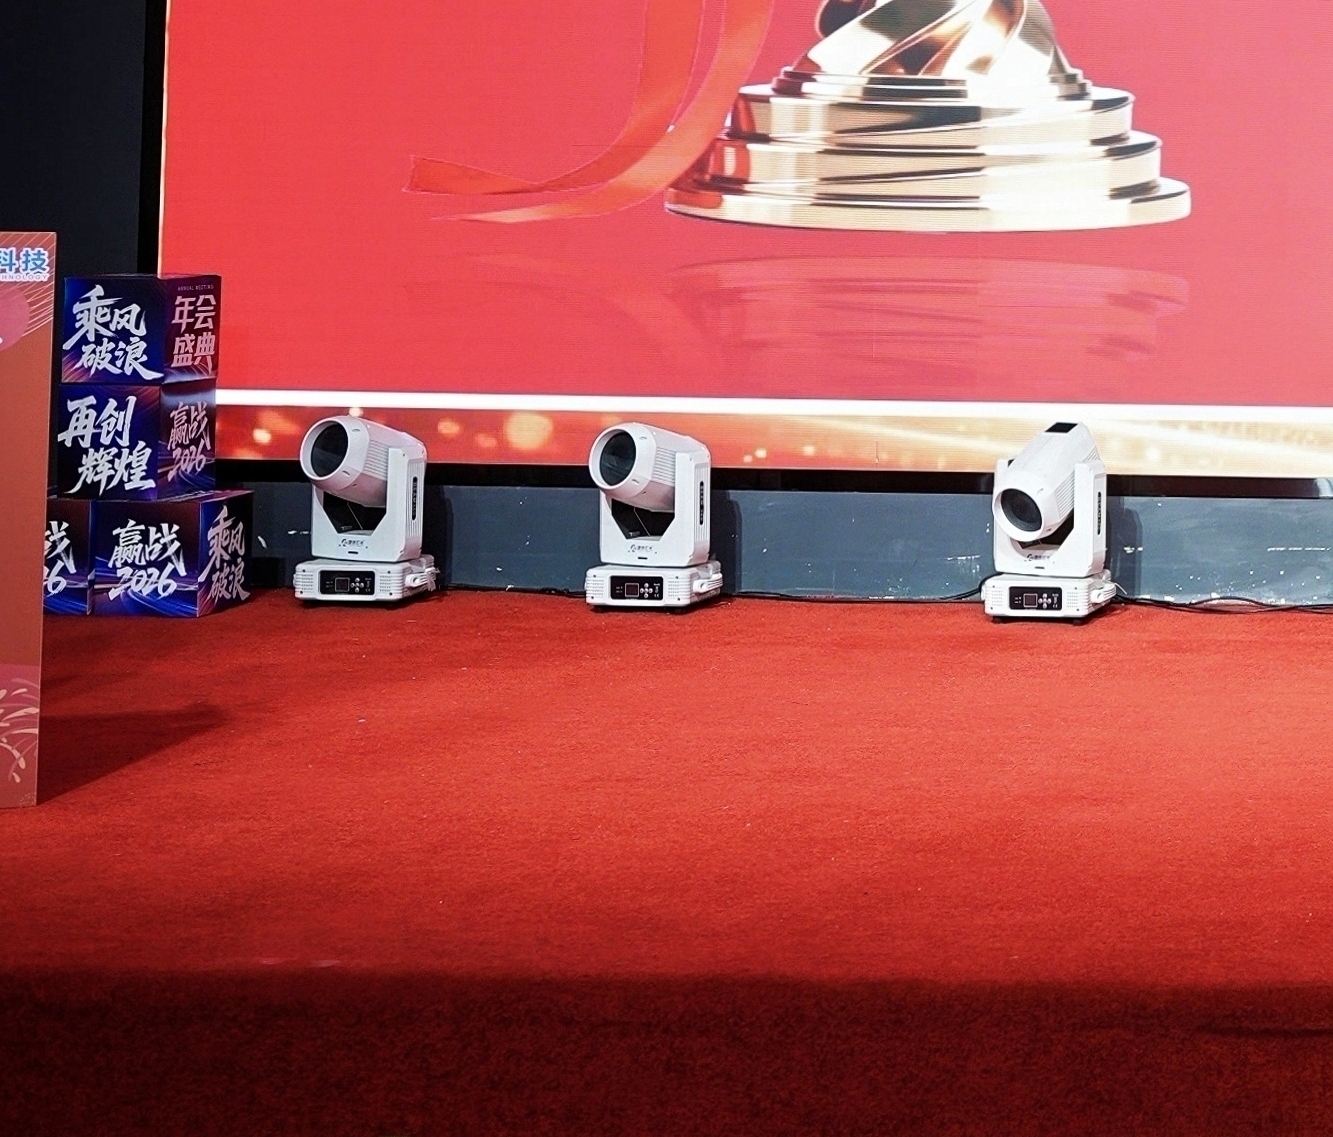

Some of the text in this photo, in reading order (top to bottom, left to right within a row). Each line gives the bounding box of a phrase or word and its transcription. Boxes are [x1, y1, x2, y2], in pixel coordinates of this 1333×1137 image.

[62, 284, 147, 351] 乘风
[171, 294, 217, 333] 年会
[73, 336, 165, 381] 破浪
[171, 332, 216, 376] 盛典
[57, 395, 138, 448] 再创
[166, 401, 211, 451] 赢战
[64, 440, 156, 496] 辉煌
[167, 441, 208, 482] 2026
[107, 518, 188, 577] 赢战
[198, 504, 246, 583] 乘风
[108, 562, 178, 601] 2026
[206, 557, 251, 604] 破浪
